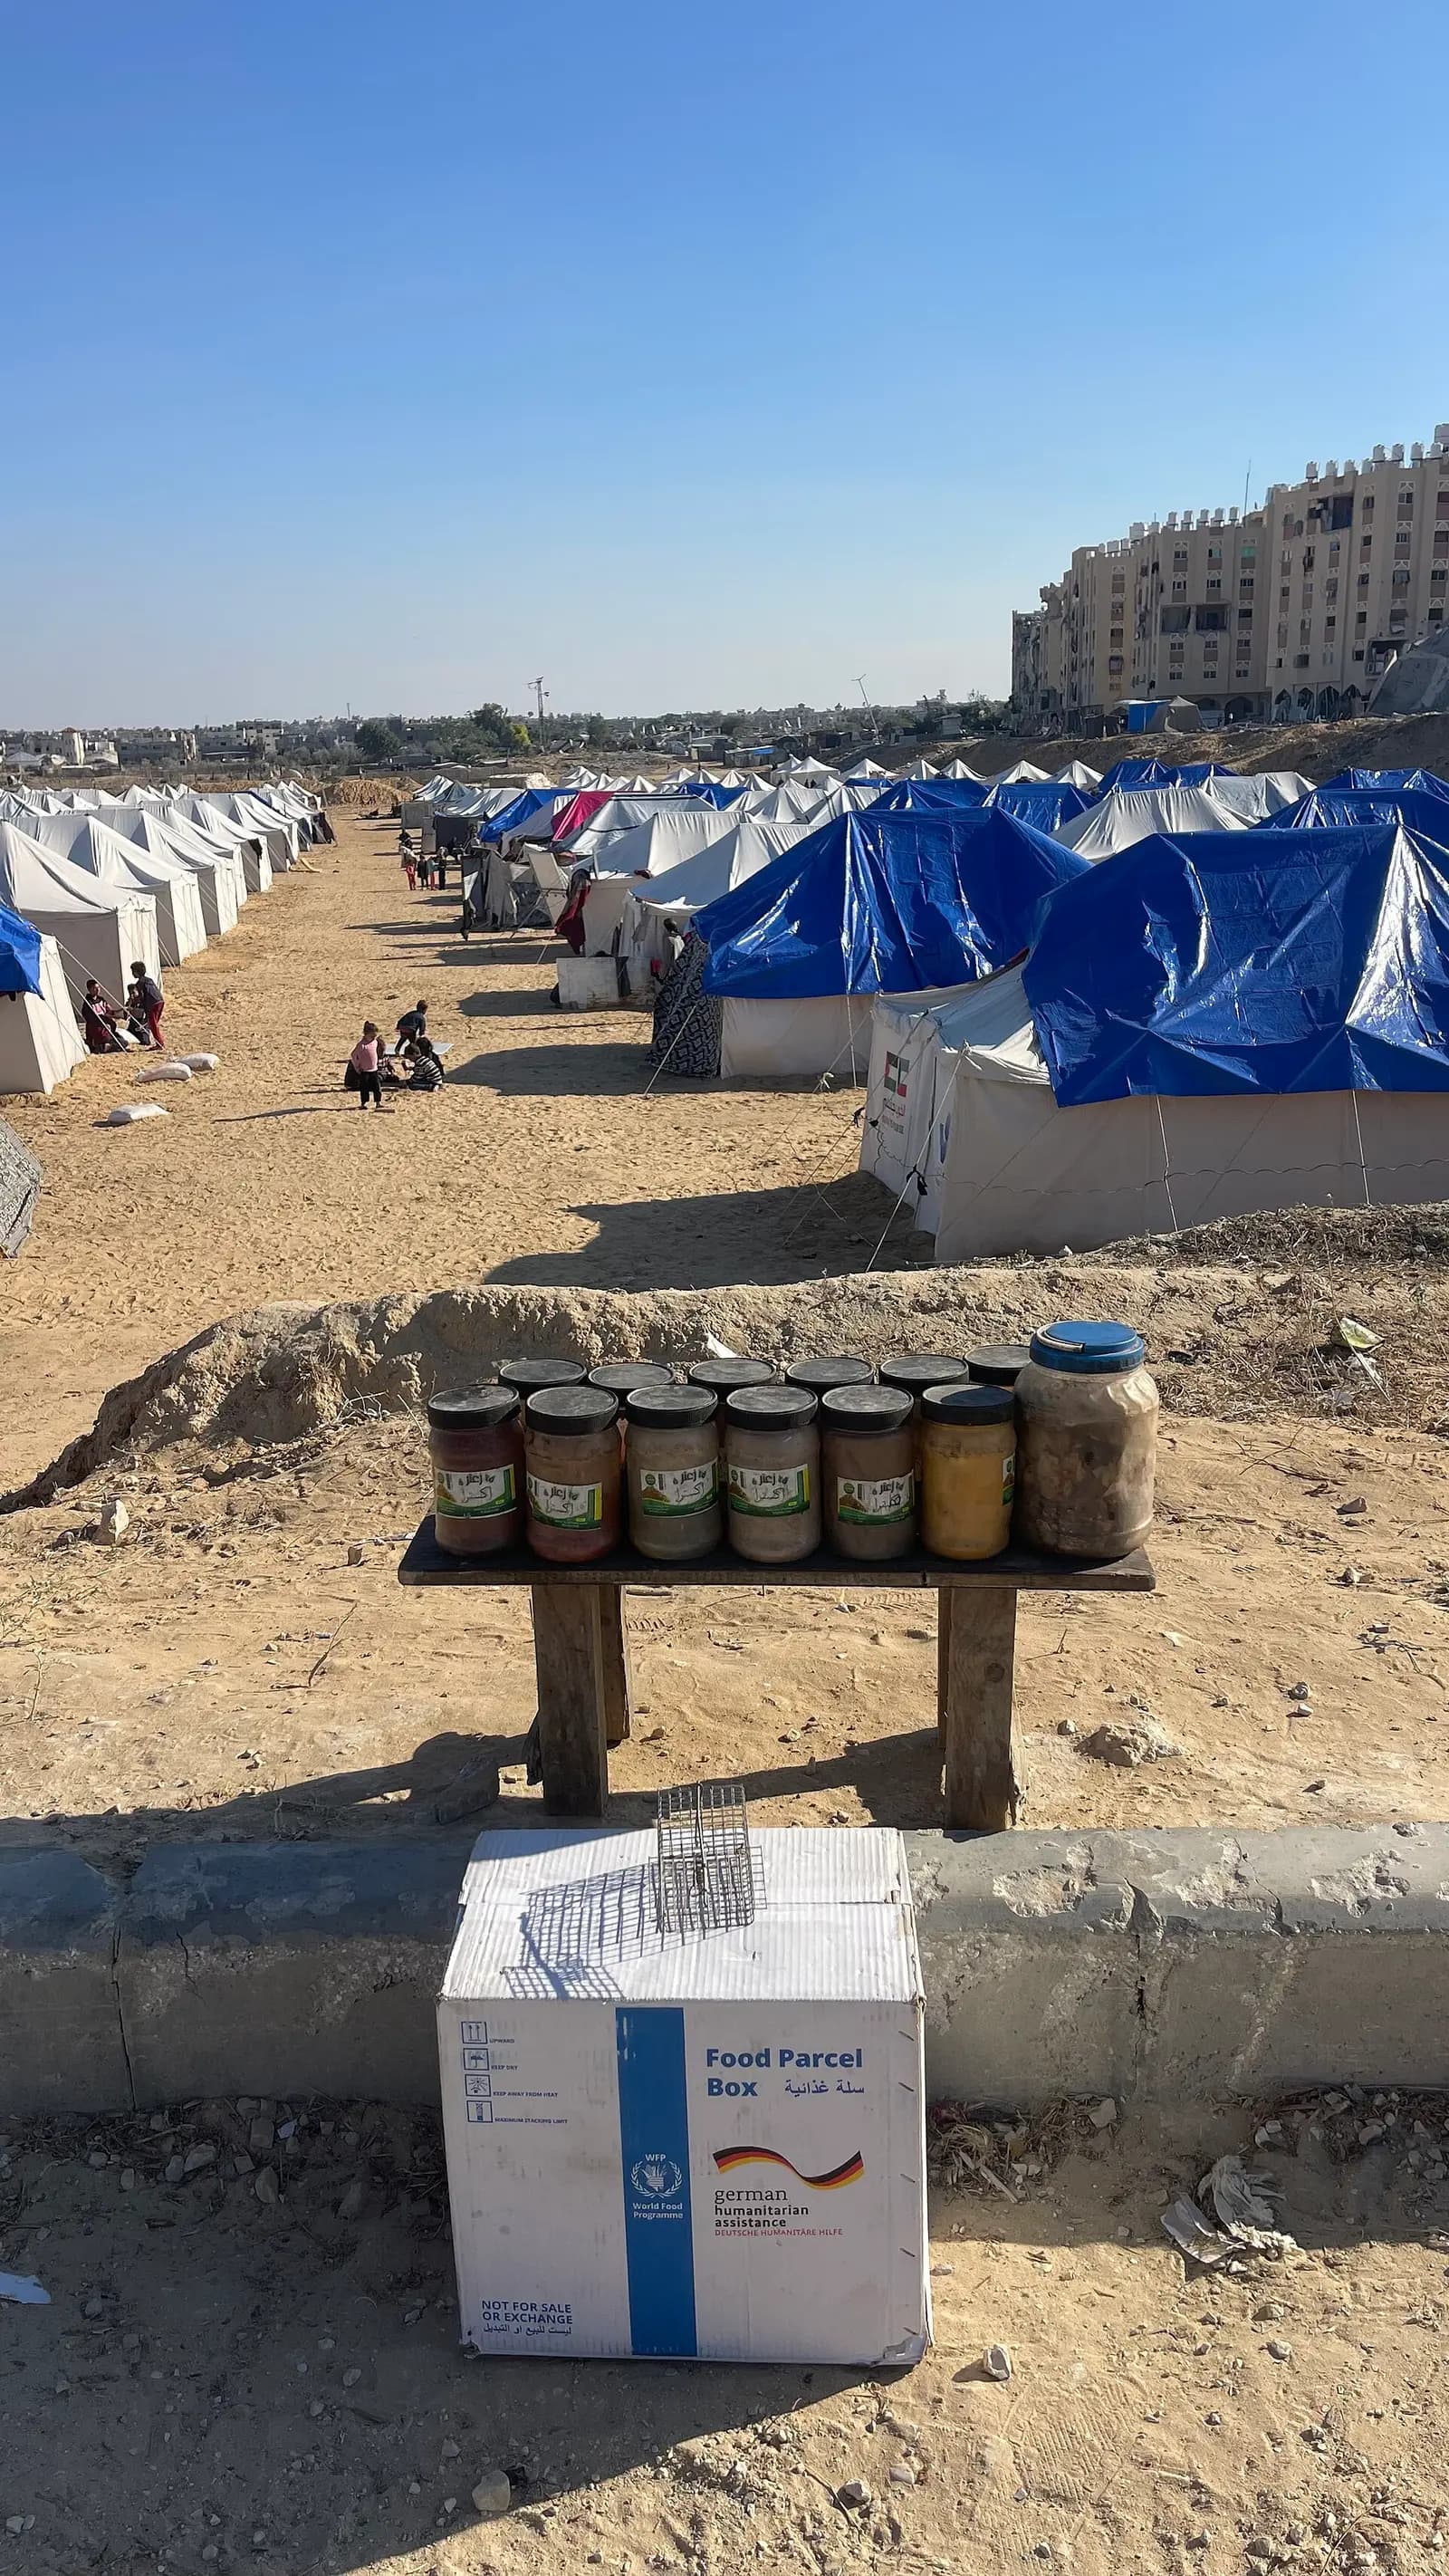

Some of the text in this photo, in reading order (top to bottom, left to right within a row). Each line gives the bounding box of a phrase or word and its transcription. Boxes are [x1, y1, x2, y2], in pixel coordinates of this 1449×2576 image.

[706, 2048, 863, 2068] Food Parcel
[707, 2078, 758, 2097] Box
[784, 2080, 865, 2098] سلة غذائية
[645, 2154, 667, 2162] WFP
[715, 2189, 789, 2205] german
[632, 2202, 683, 2210] World Food
[715, 2205, 809, 2216] humanitarian
[633, 2211, 684, 2220] Programme
[715, 2216, 787, 2227] assistance
[715, 2228, 758, 2236] DEUTSCHE
[761, 2227, 816, 2236] HUMANITÄRE
[482, 2300, 571, 2313] NOT FOR SALE
[482, 2312, 573, 2324] OR EXCHANGE
[483, 2322, 510, 2333] التبديل
[525, 2325, 545, 2336] للبيع
[548, 2325, 571, 2336] ليست
